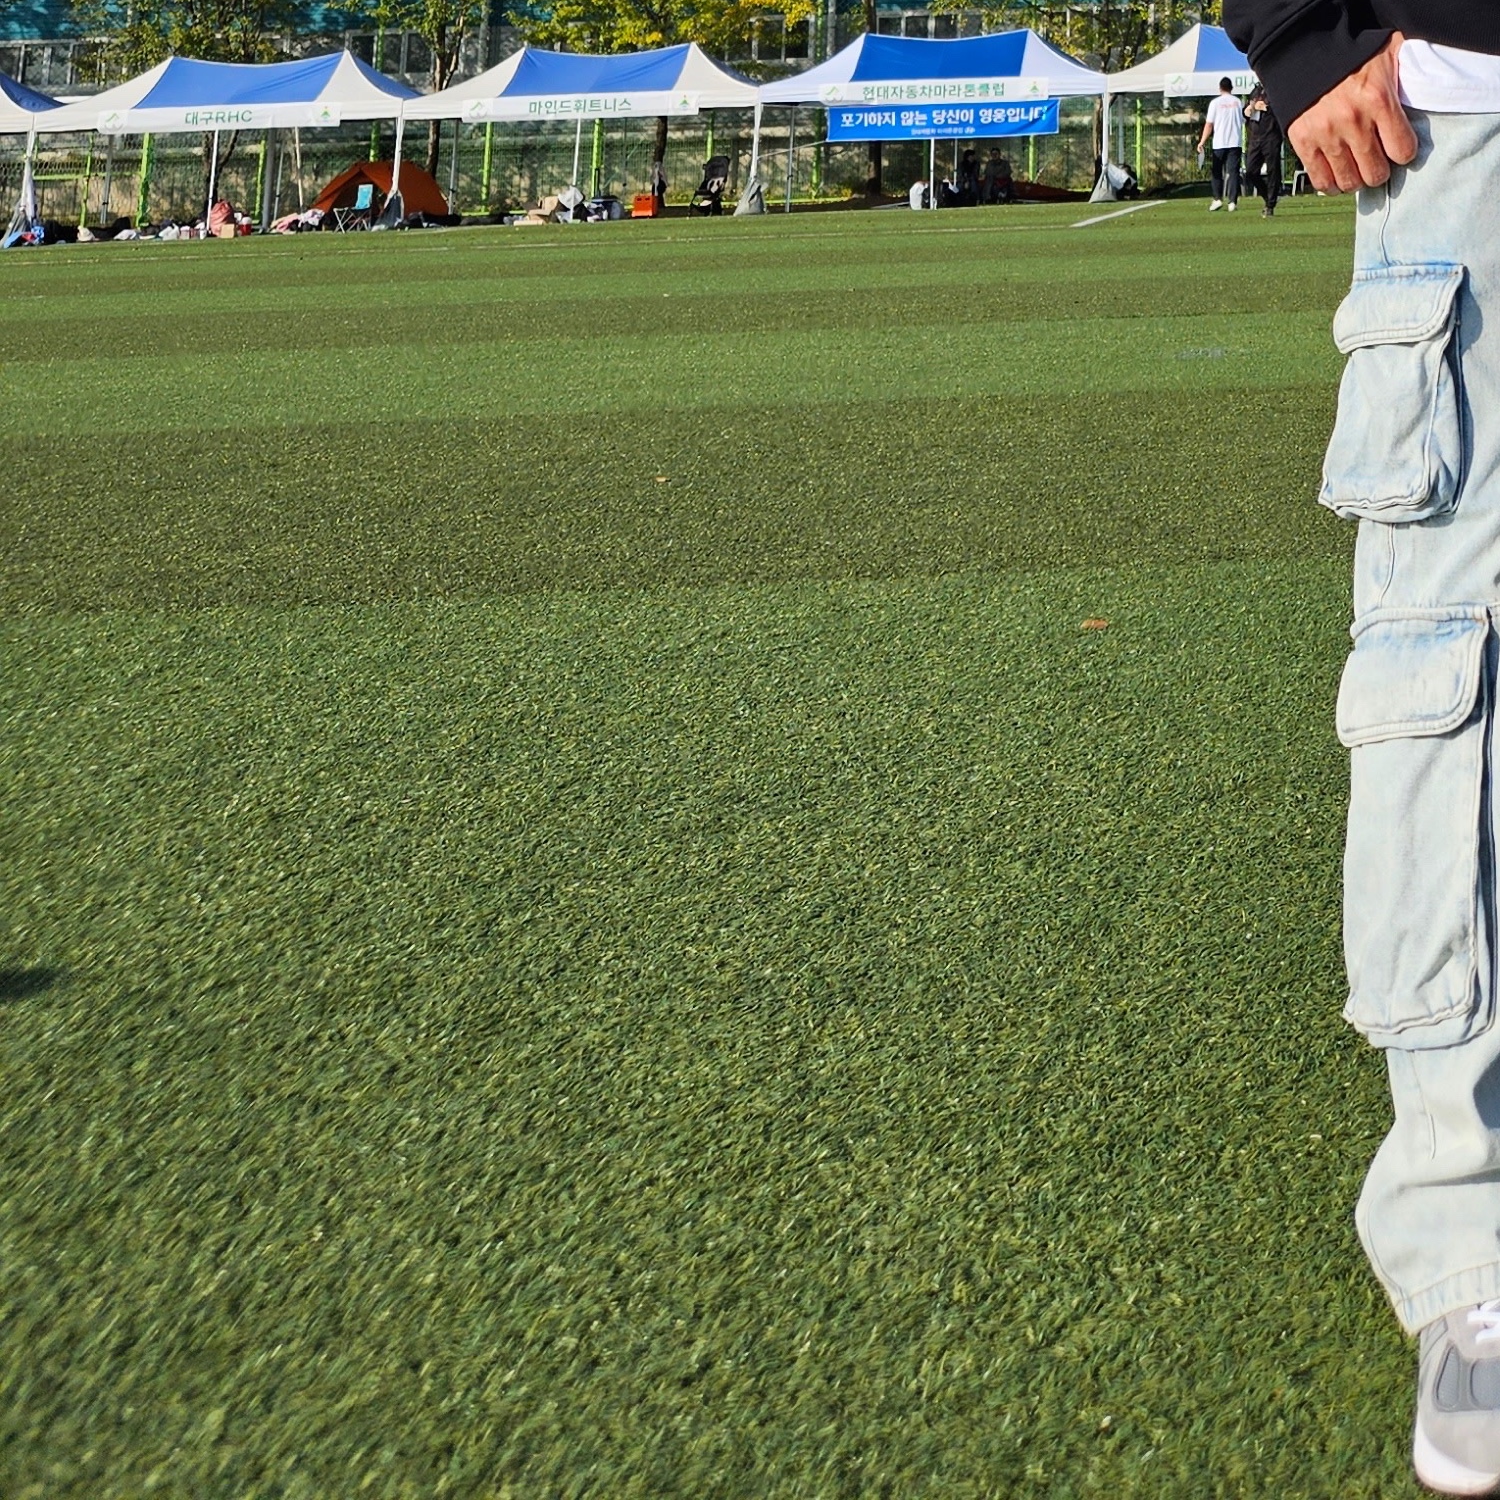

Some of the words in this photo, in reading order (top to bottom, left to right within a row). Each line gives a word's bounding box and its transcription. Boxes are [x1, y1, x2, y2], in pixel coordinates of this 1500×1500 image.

[529, 97, 632, 115] 마인드휘트니스
[184, 109, 254, 126] 대구RHC
[840, 111, 896, 128] 포기하지
[900, 110, 928, 127] 않는
[932, 108, 975, 125] 당신이
